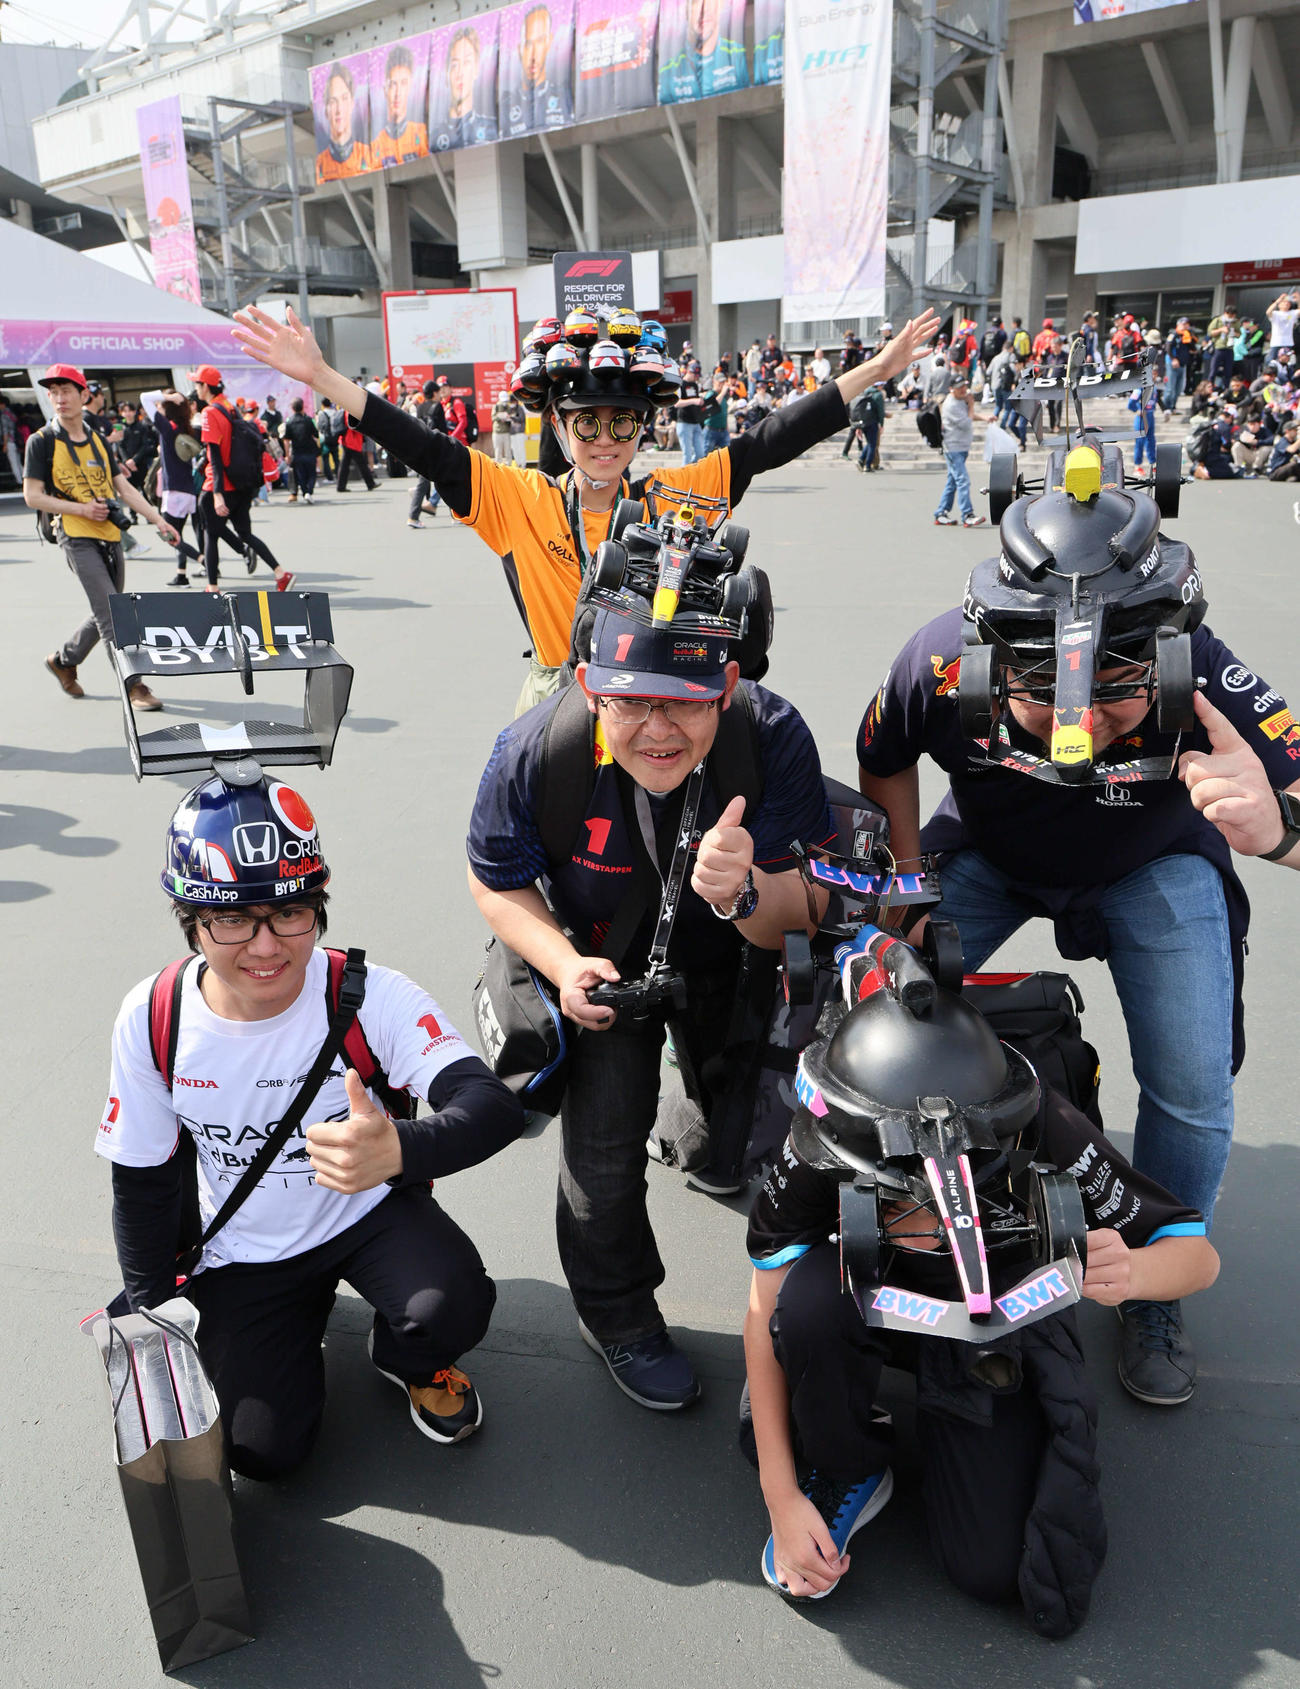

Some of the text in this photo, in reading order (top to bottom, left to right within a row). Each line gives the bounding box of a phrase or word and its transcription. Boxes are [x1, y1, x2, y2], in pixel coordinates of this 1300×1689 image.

[564, 284, 625, 292] RESPECT FOR
[565, 293, 622, 302] ALL DRIVERS
[565, 303, 575, 311] IN
[69, 336, 185, 350] OFFICIAL SHOP
[1140, 545, 1159, 577] ROKT
[614, 634, 635, 662] 1
[1065, 649, 1081, 672] 1
[1056, 744, 1086, 755] HRC
[1000, 757, 1037, 774] Red
[1011, 750, 1052, 769] BYBIT
[1107, 772, 1143, 784] Bull
[1096, 797, 1144, 807] HONDA
[584, 817, 612, 855] 1
[583, 859, 632, 873] VERSTAPPEN
[275, 877, 305, 896] BYBIT
[810, 859, 926, 896] BWT
[416, 1013, 443, 1040] 1
[1066, 1142, 1098, 1177] BWT
[946, 1169, 962, 1212] ALPINE
[998, 1269, 1068, 1321] BWT
[874, 1287, 948, 1325] BWT
